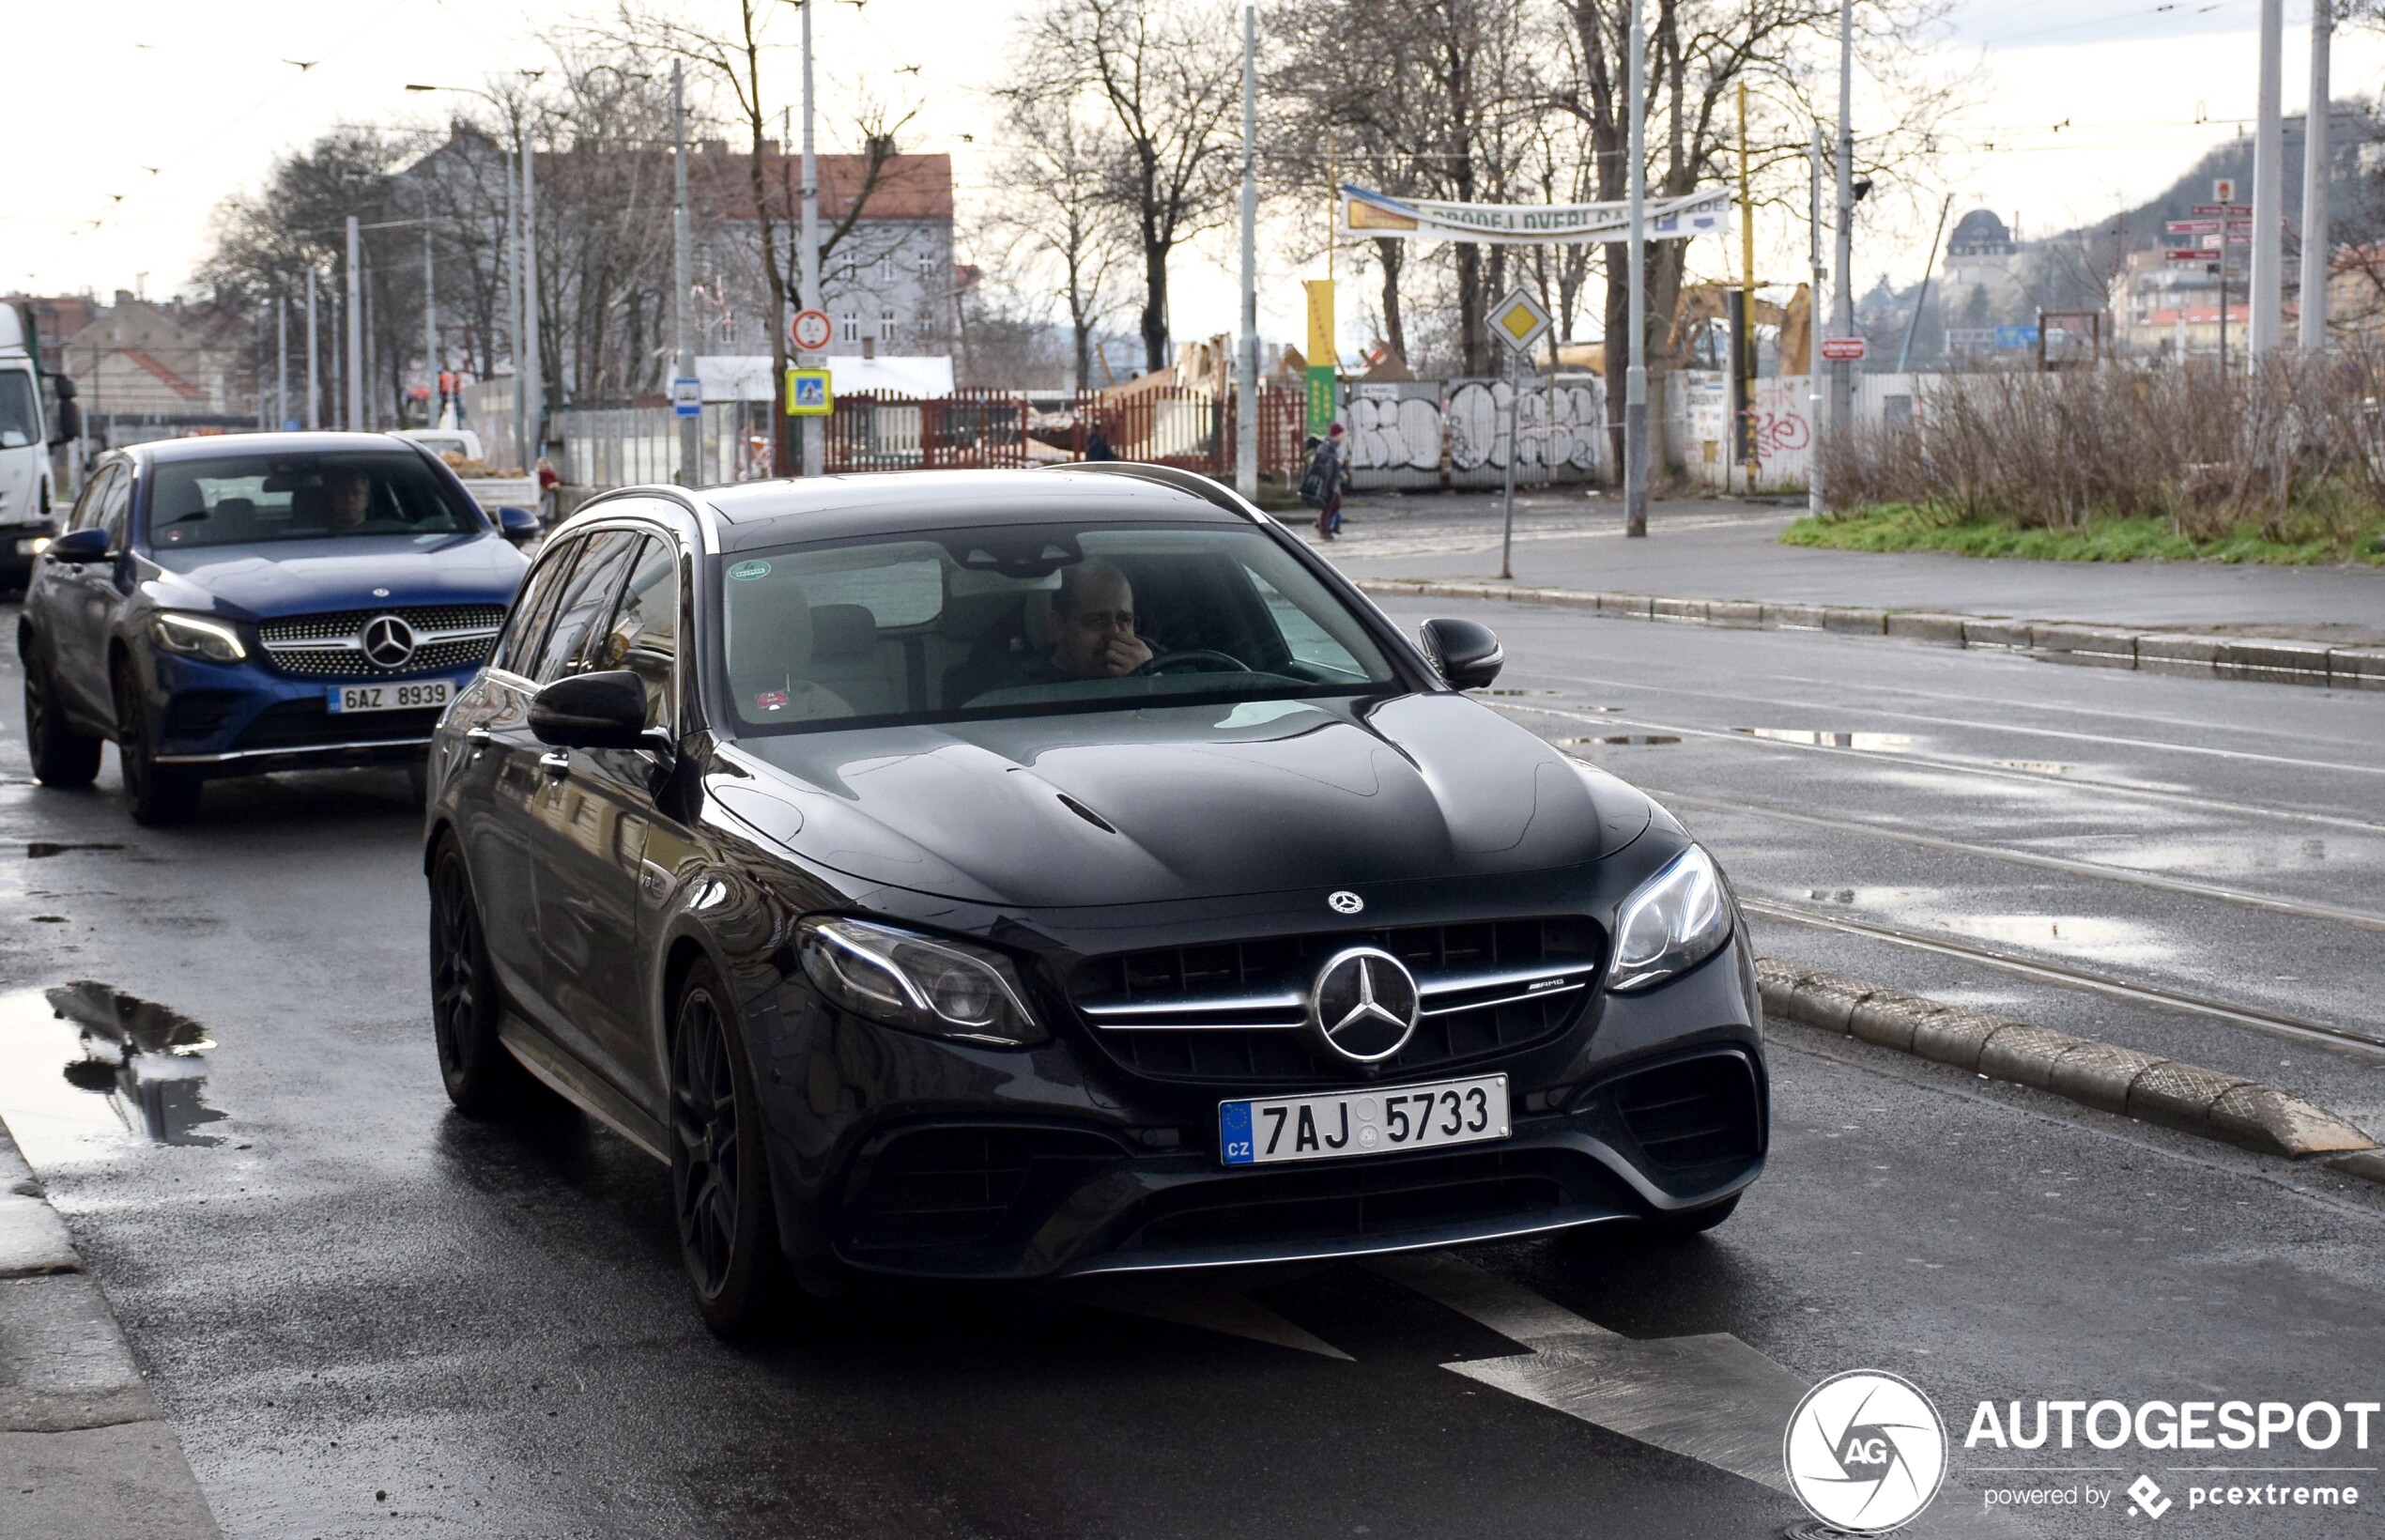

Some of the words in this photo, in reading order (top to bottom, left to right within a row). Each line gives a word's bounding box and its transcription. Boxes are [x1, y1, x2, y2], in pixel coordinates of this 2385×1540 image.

[346, 688, 382, 709] 6AZ
[398, 684, 446, 705] 8939
[1540, 978, 1564, 988] AMG
[1228, 1142, 1249, 1157] CZ
[1263, 1101, 1349, 1155] 7AJ
[1385, 1086, 1488, 1143] 5733
